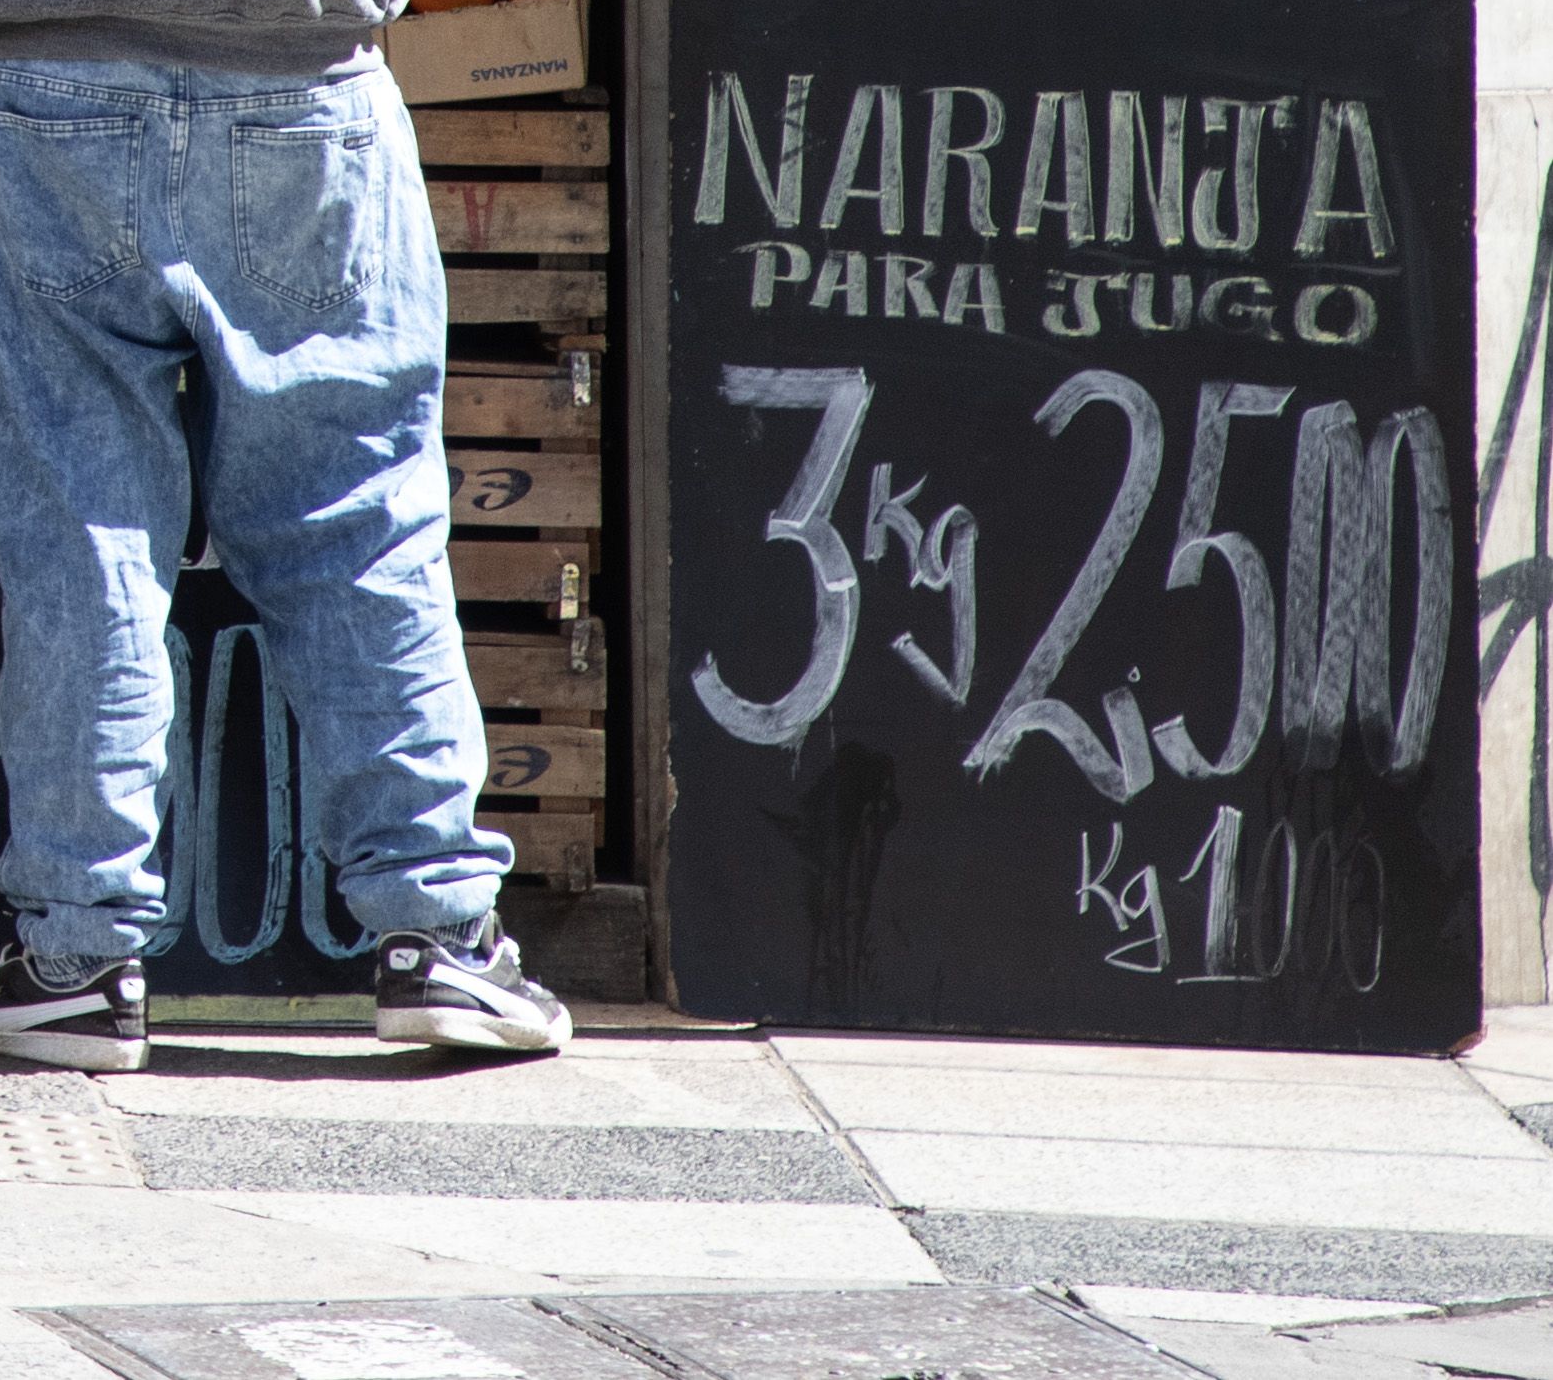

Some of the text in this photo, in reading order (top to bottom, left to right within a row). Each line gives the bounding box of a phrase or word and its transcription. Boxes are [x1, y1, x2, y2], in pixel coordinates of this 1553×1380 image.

[470, 58, 568, 83] MANZANAS
[692, 71, 1398, 258] NARANJA
[734, 240, 1379, 346] PARA JUGO
[962, 368, 1454, 804] 2500
